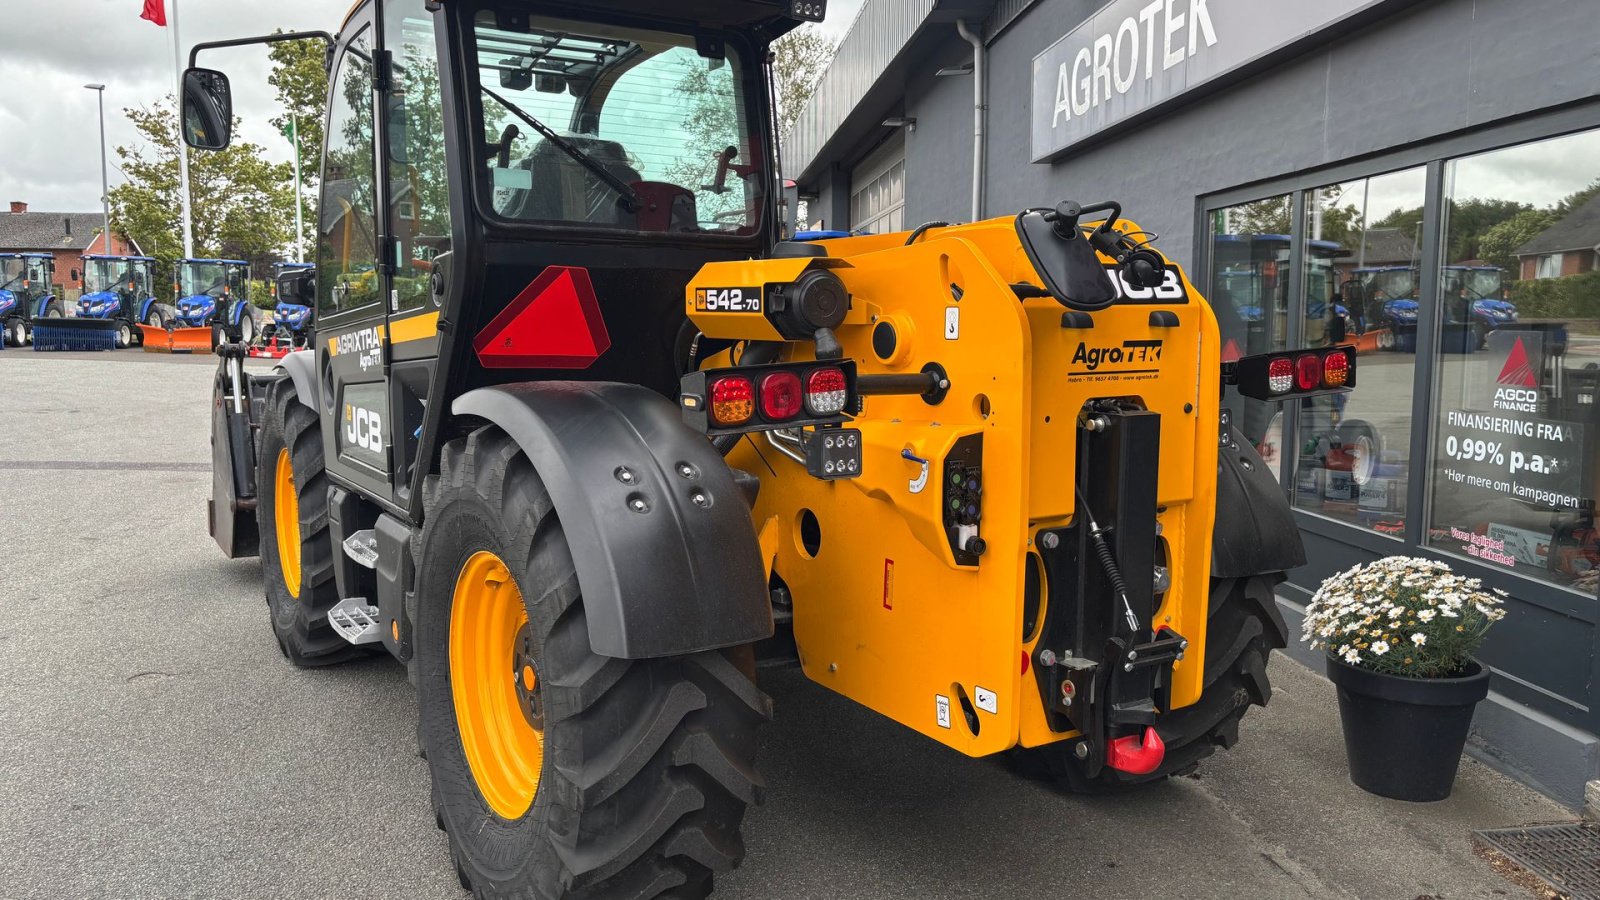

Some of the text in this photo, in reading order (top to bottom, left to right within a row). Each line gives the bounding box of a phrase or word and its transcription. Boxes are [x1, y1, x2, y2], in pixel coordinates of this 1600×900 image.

[1052, 0, 1218, 128] AGROTEK
[336, 327, 381, 356] AGRIXTRA
[1071, 340, 1163, 370] AgroTEK
[1493, 401, 1537, 412] FINANCE
[1494, 388, 1537, 403] AGCO
[347, 406, 382, 453] JCB
[1448, 412, 1563, 441] FINANSIERING FRA
[1446, 436, 1504, 465] 0,99%
[1467, 474, 1492, 488] mere
[1493, 481, 1510, 493] om
[1512, 481, 1578, 508] kampagnen
[1450, 527, 1504, 551] Vores faglighed
[1468, 544, 1479, 556] din
[1479, 548, 1515, 567] sikkerhed
